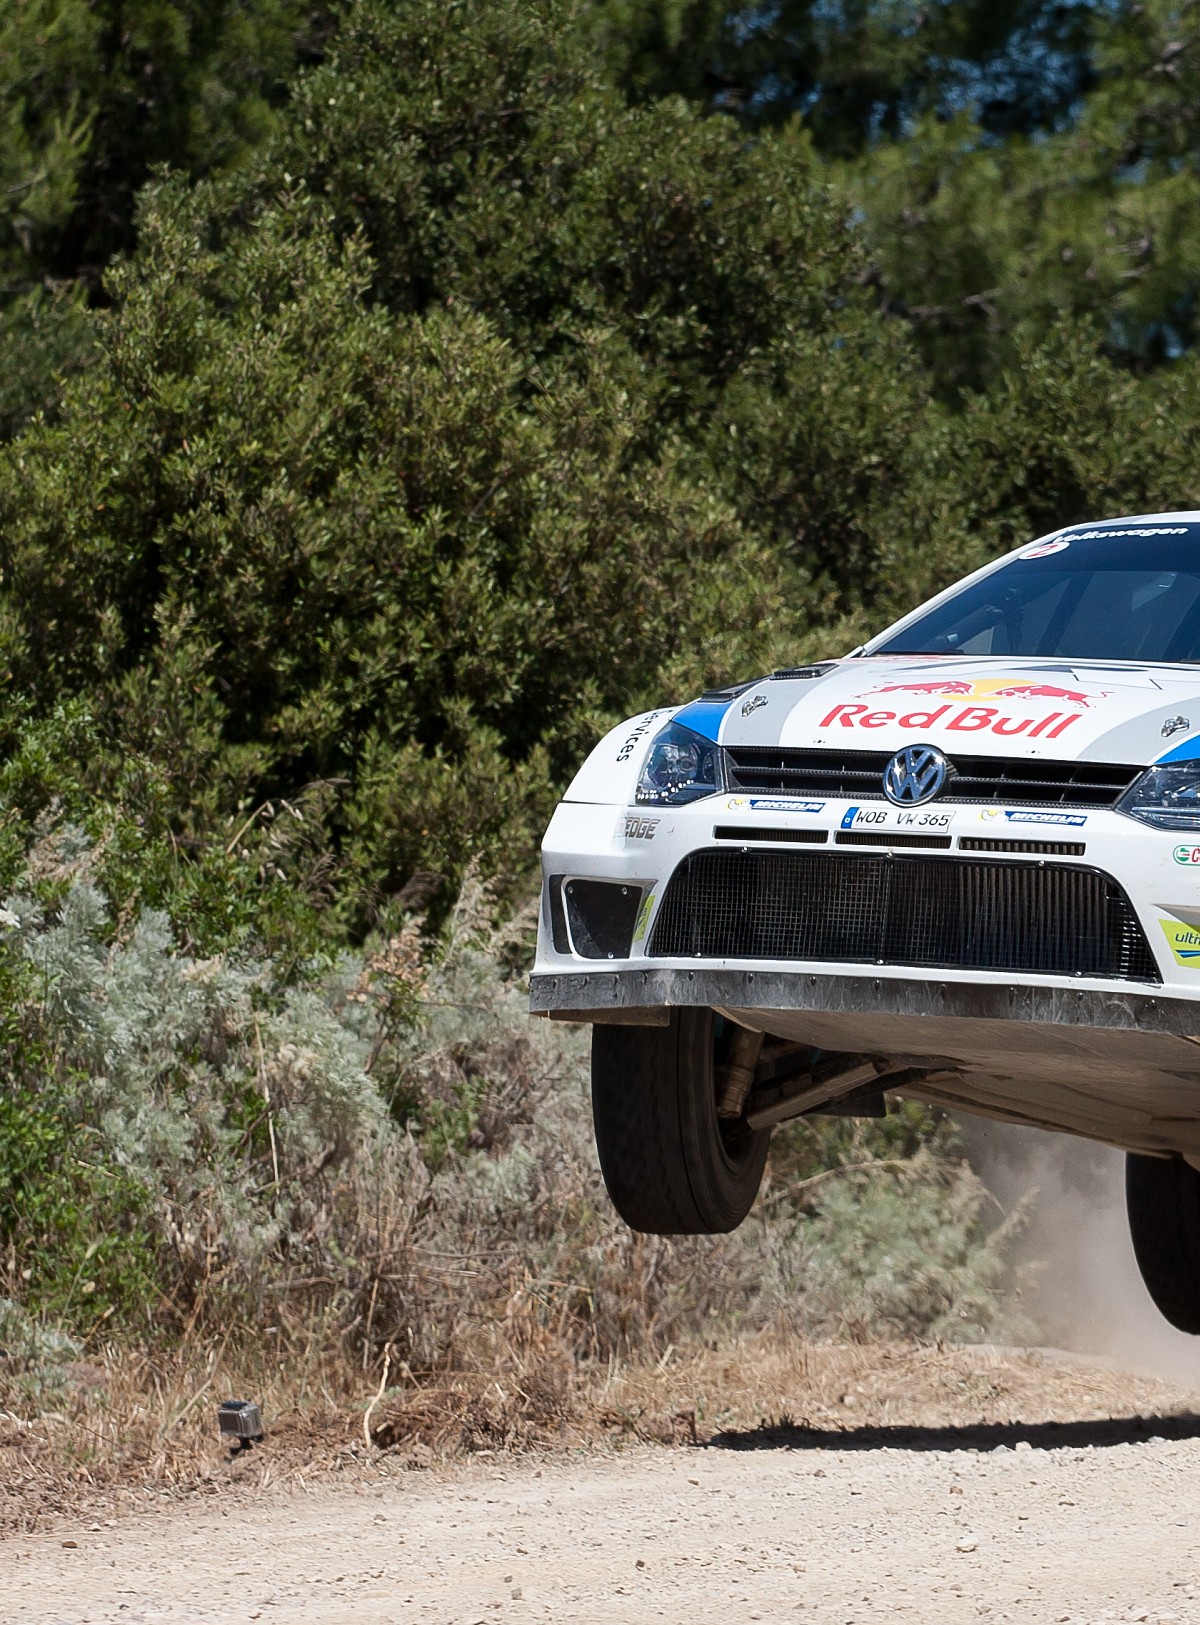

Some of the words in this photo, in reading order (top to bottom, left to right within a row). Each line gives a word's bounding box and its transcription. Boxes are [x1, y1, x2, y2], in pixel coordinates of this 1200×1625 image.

[819, 704, 951, 729] Red
[944, 707, 1084, 738] Bull
[752, 800, 821, 811] MICHELIN
[856, 811, 887, 823] WOB
[897, 813, 918, 825] VW
[919, 814, 951, 826] 365
[1009, 812, 1087, 825] MICHELIN
